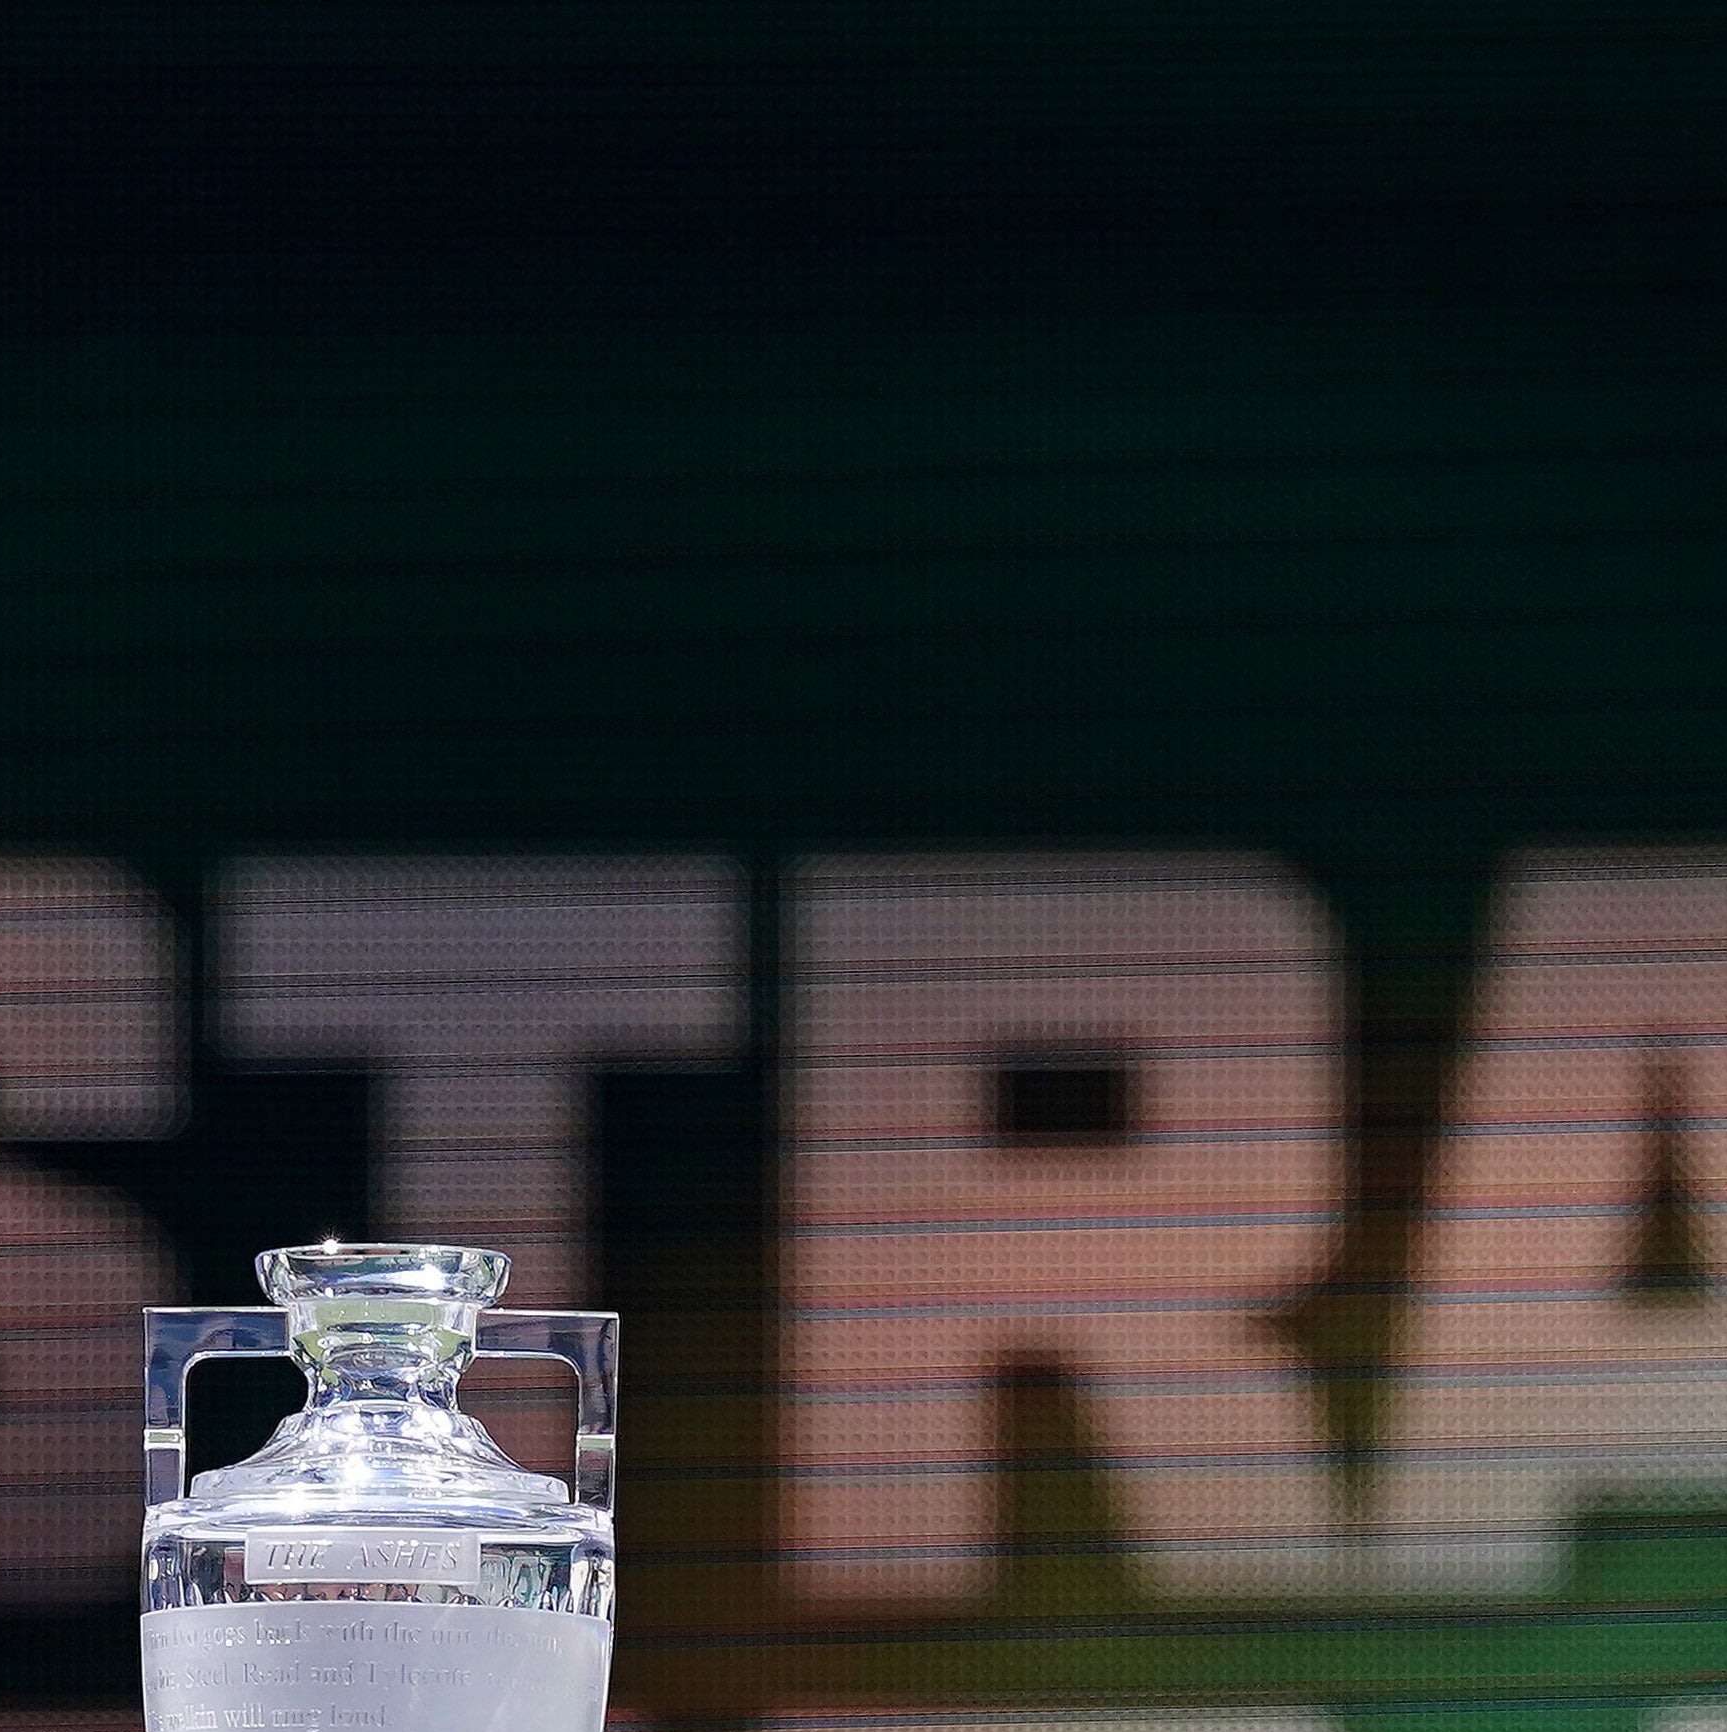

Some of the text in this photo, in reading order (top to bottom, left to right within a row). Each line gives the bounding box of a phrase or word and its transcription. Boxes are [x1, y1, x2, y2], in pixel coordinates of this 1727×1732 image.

[264, 1538, 461, 1570] THE ASHES
[319, 1618, 375, 1643] with
[384, 1619, 422, 1645] the
[242, 1660, 301, 1686] Read
[309, 1660, 357, 1686] and
[224, 1702, 265, 1729] will
